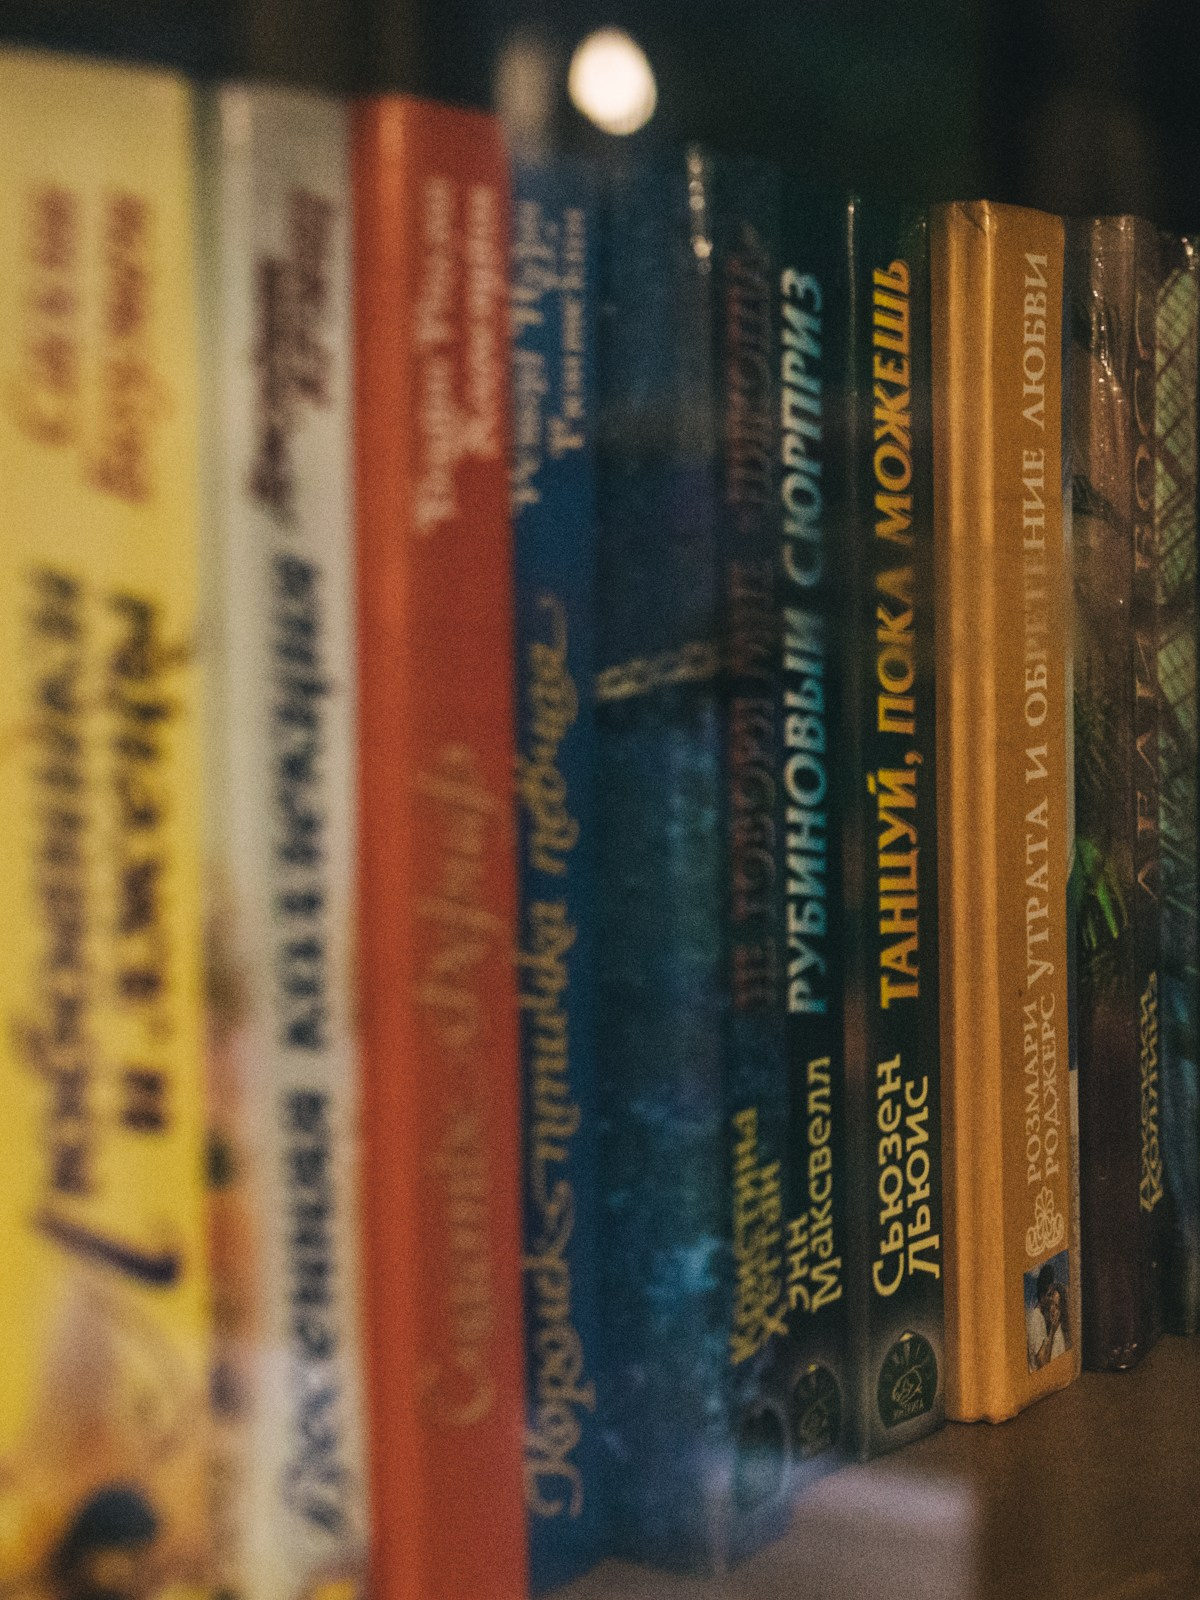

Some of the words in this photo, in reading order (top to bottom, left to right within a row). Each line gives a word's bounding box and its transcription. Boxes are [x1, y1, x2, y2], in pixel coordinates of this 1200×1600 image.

[782, 268, 825, 585] СЮРПРИЗ
[873, 259, 912, 543] МОЖЕШЬ
[1021, 251, 1047, 430] ЛЮБВИ
[875, 566, 916, 733] ПОКА
[1022, 449, 1047, 726] ОБРЕТЕНИЕ
[1024, 743, 1048, 782] И
[867, 751, 922, 1008] ТАНЦУЙ,
[1024, 800, 1055, 988] УТРАТА
[872, 1053, 911, 1296] Сьюзен
[902, 1075, 941, 1278] Льюис
[1024, 1003, 1042, 1183] РОЗМАРИ
[1041, 993, 1060, 1175] РОДЖЕРС
[787, 1213, 811, 1312] Энн
[807, 1057, 843, 1312] Максвелл
